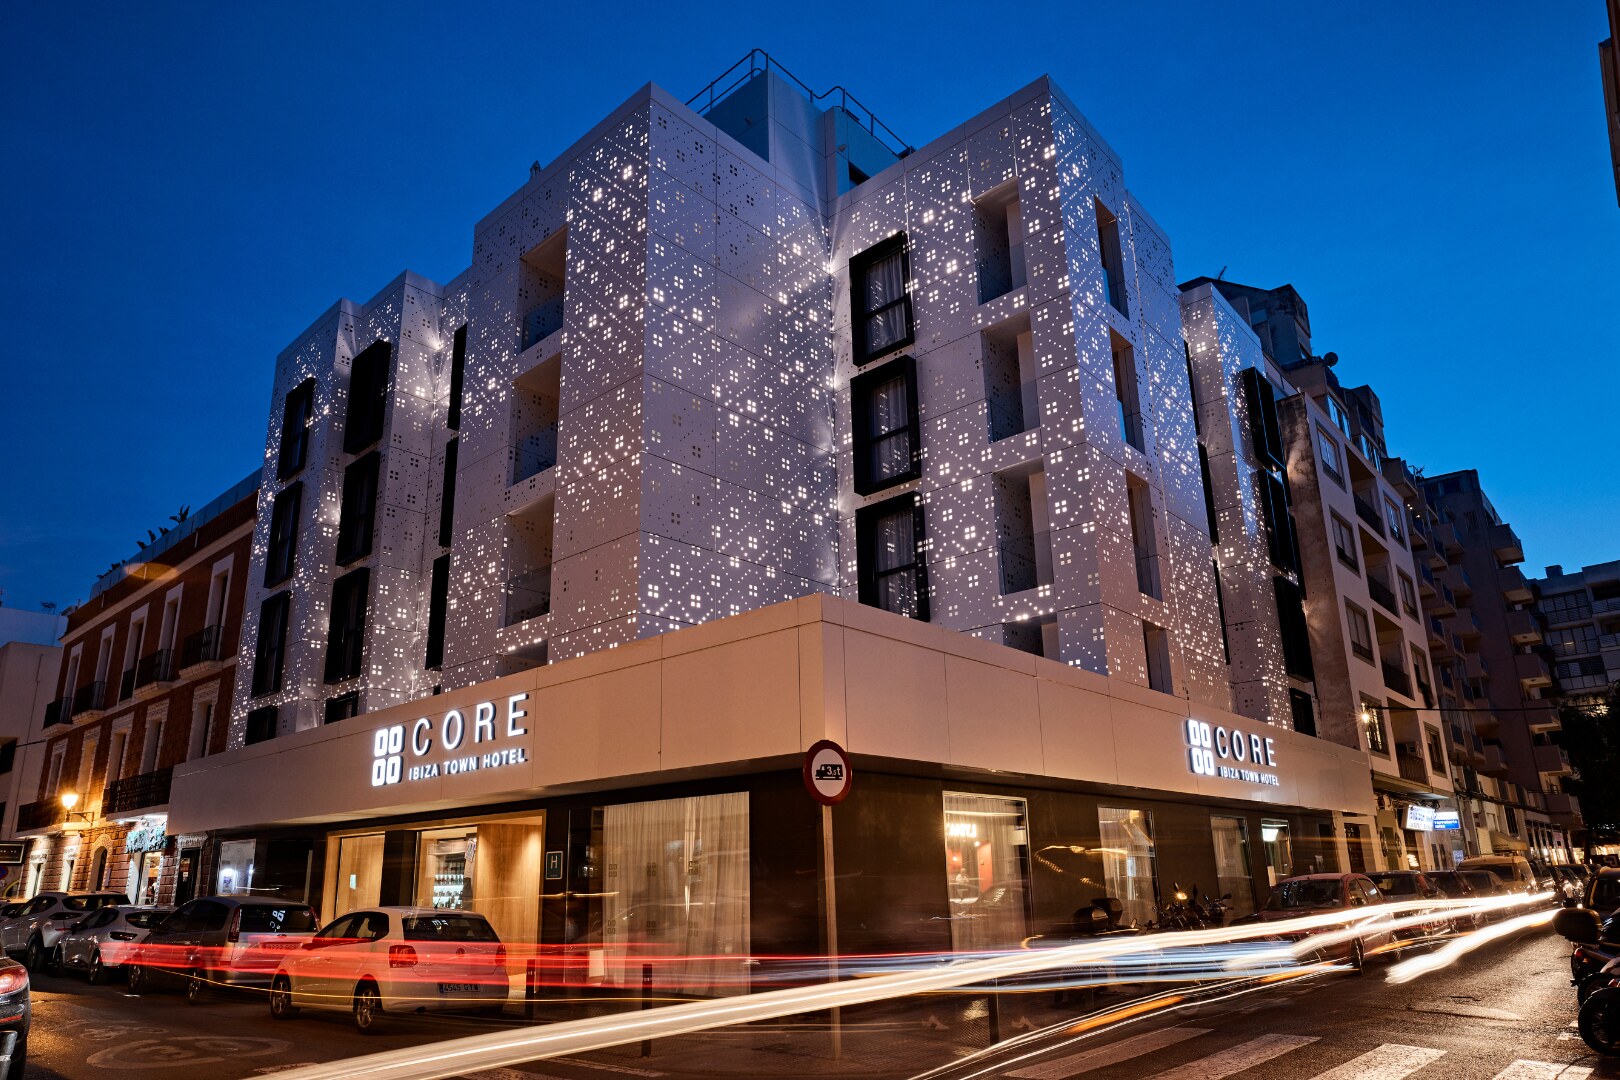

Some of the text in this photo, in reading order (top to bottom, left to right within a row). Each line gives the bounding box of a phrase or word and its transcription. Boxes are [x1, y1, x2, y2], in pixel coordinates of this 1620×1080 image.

[412, 694, 528, 756] CORE
[1215, 726, 1277, 767] CORE
[408, 749, 528, 781] IBIZA TOWN HOTEL
[1219, 766, 1280, 786] IBIZA TOWN HOTEL
[550, 855, 558, 869] H
